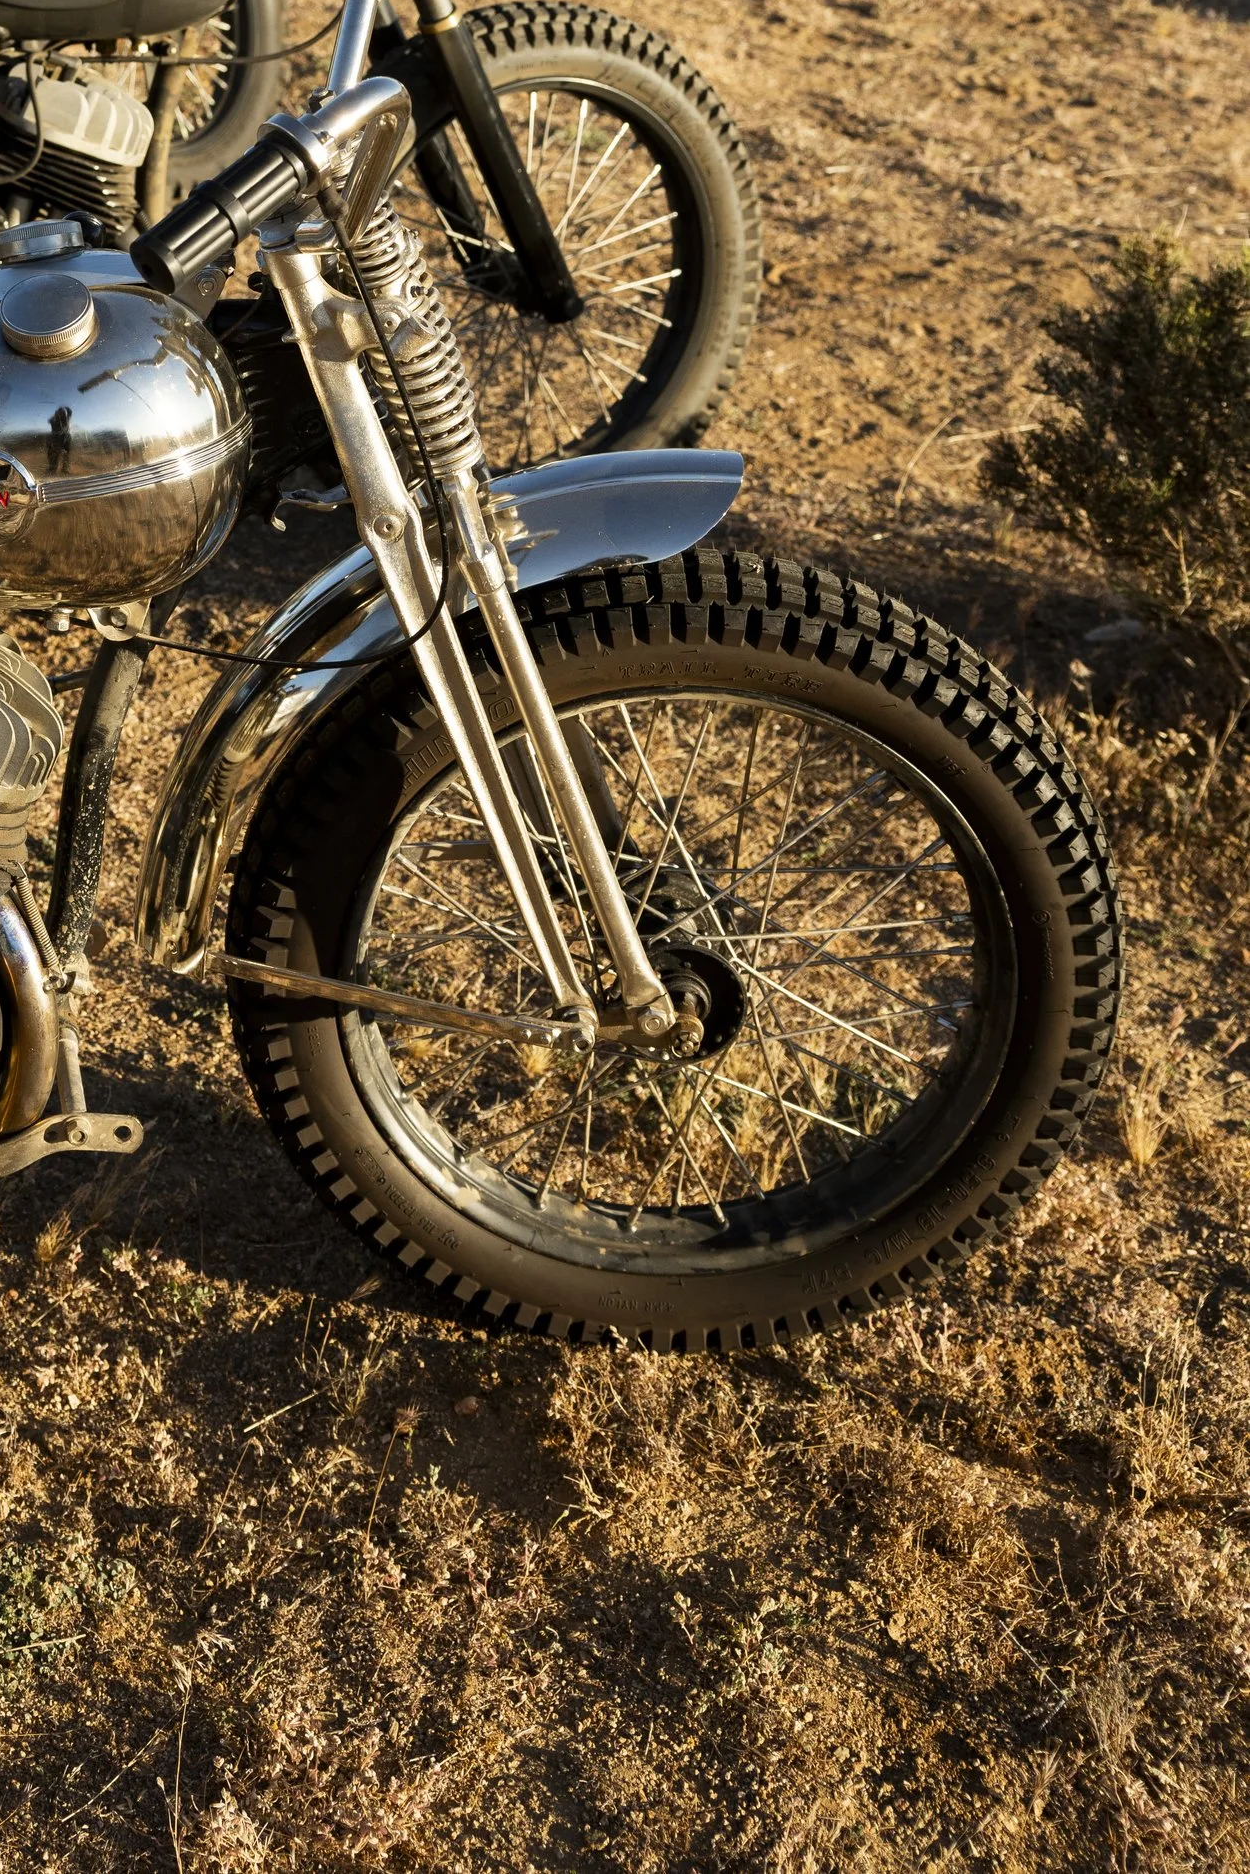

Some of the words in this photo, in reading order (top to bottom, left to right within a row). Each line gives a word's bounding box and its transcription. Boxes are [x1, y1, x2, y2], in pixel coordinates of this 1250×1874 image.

[618, 661, 719, 679] TRAIL
[743, 664, 824, 695] TIRE
[915, 1151, 997, 1230] 3.50-19
[862, 1228, 914, 1266] M/C
